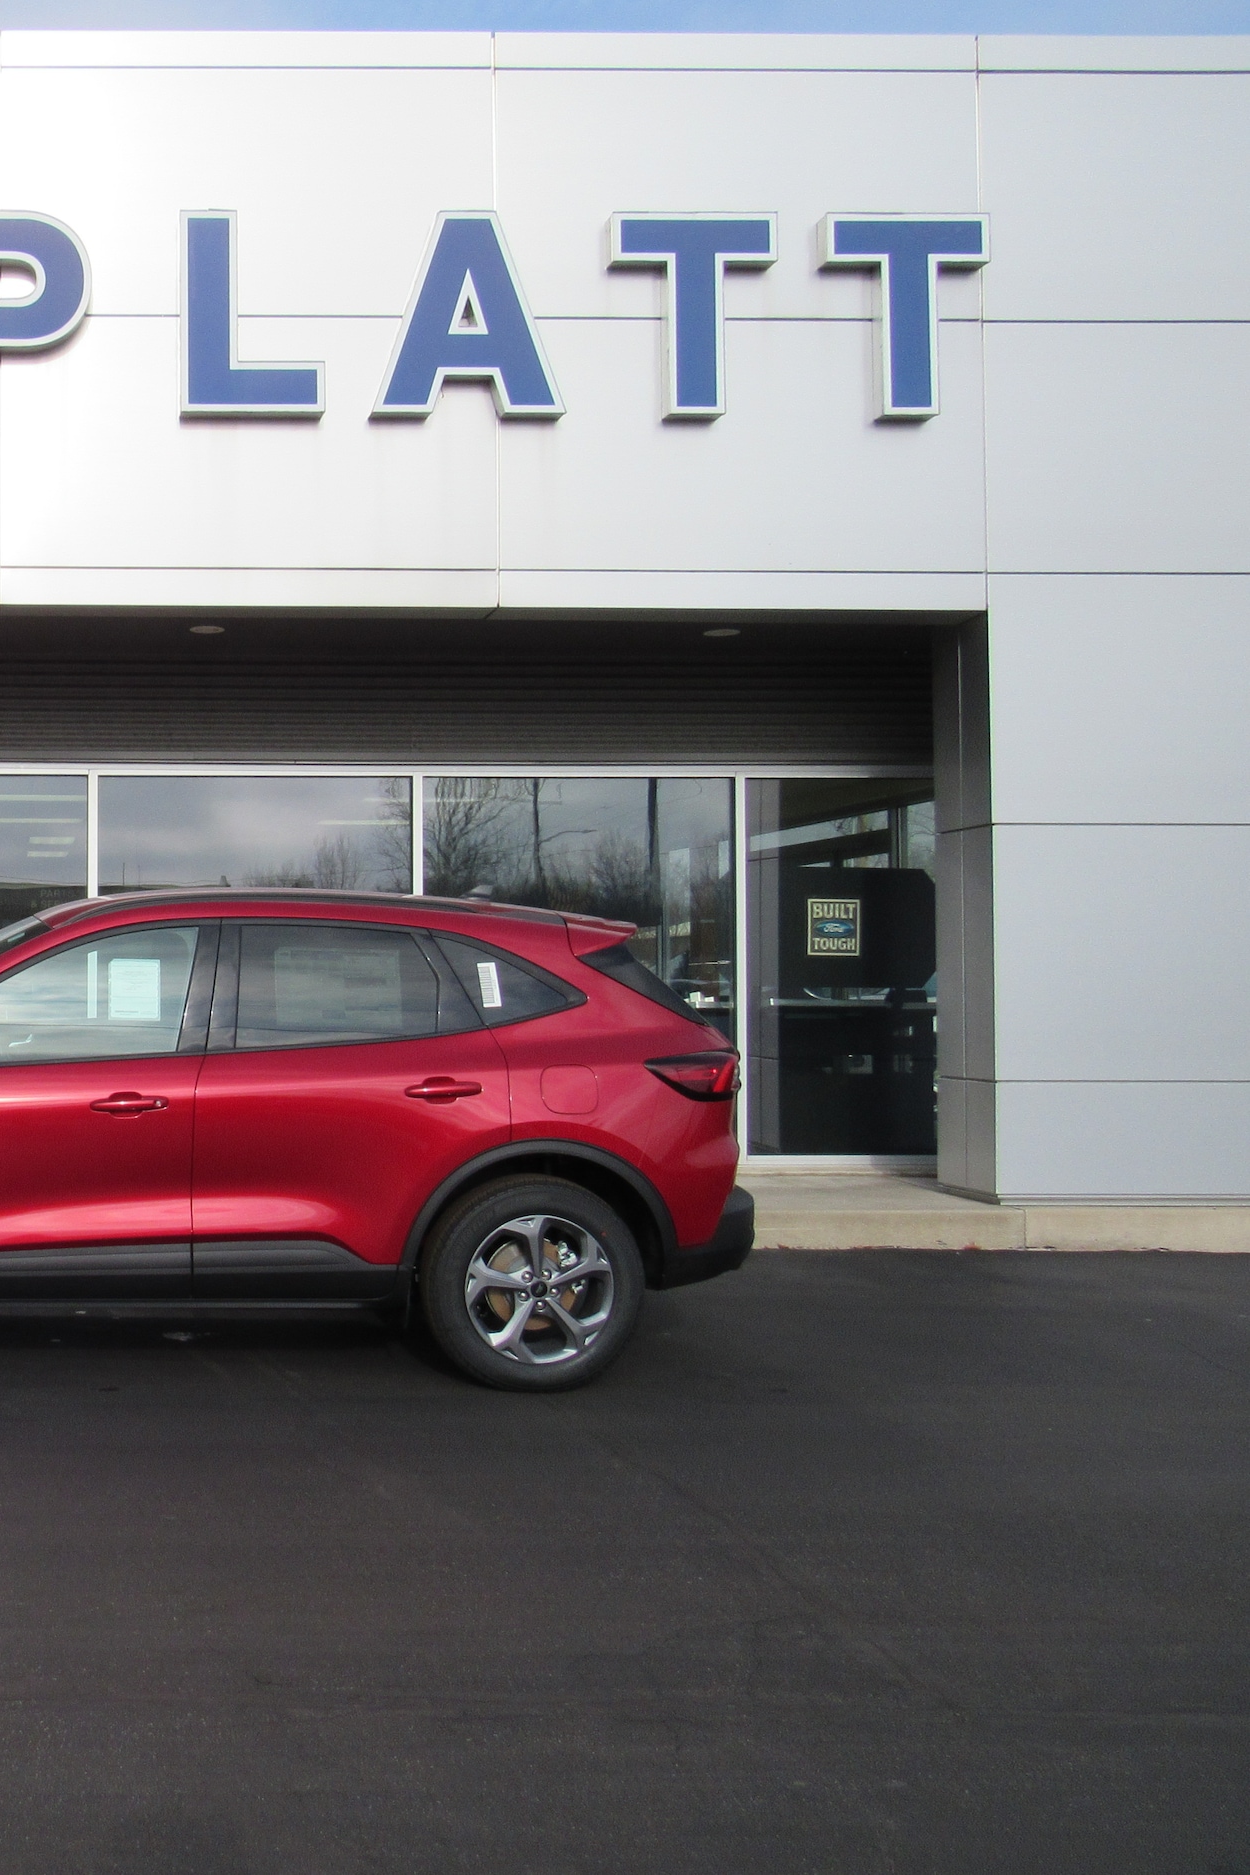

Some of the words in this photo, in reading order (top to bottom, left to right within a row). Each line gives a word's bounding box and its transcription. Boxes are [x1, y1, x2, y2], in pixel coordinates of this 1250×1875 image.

[812, 903, 855, 918] BUILT
[823, 922, 844, 933] Ford
[812, 938, 856, 950] TOUGH
